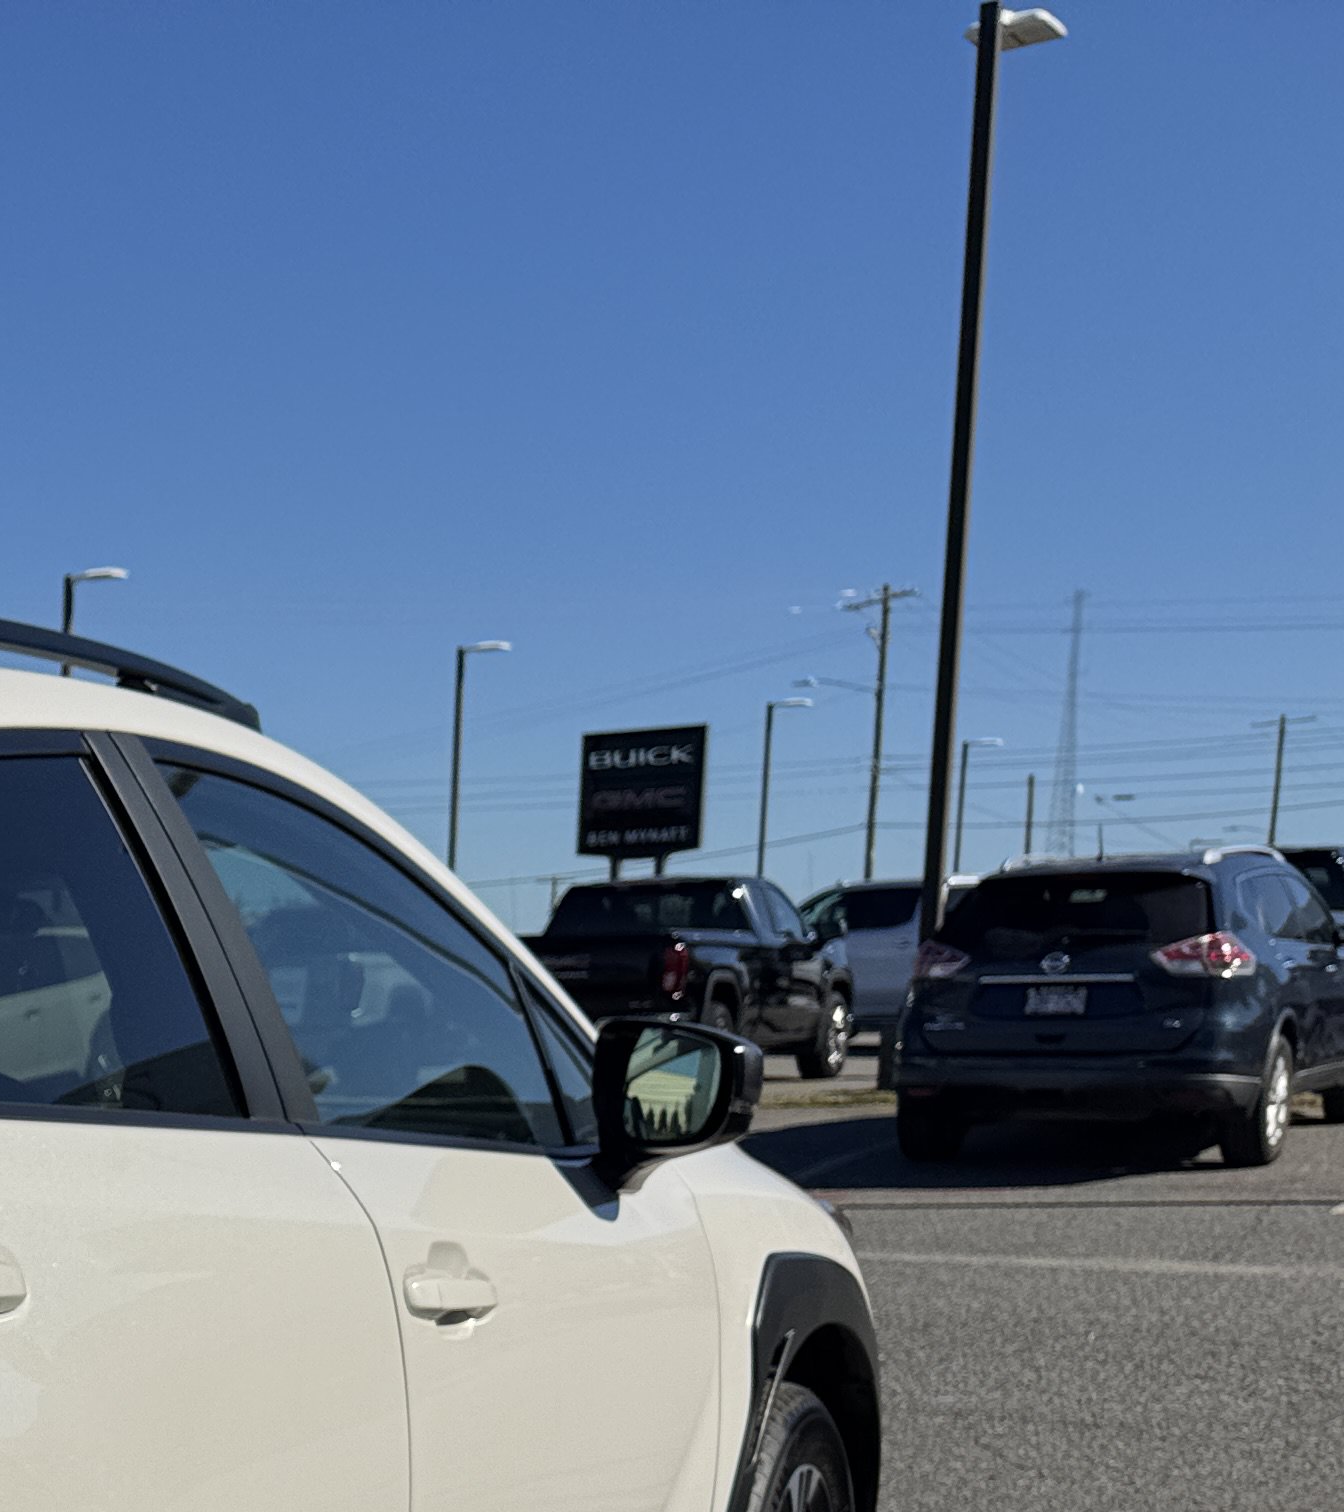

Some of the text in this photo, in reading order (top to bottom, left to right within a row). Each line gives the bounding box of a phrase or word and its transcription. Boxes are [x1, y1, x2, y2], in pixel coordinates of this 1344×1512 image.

[587, 743, 694, 770] BUICK
[591, 786, 687, 810] GMC
[585, 830, 620, 847] BEN
